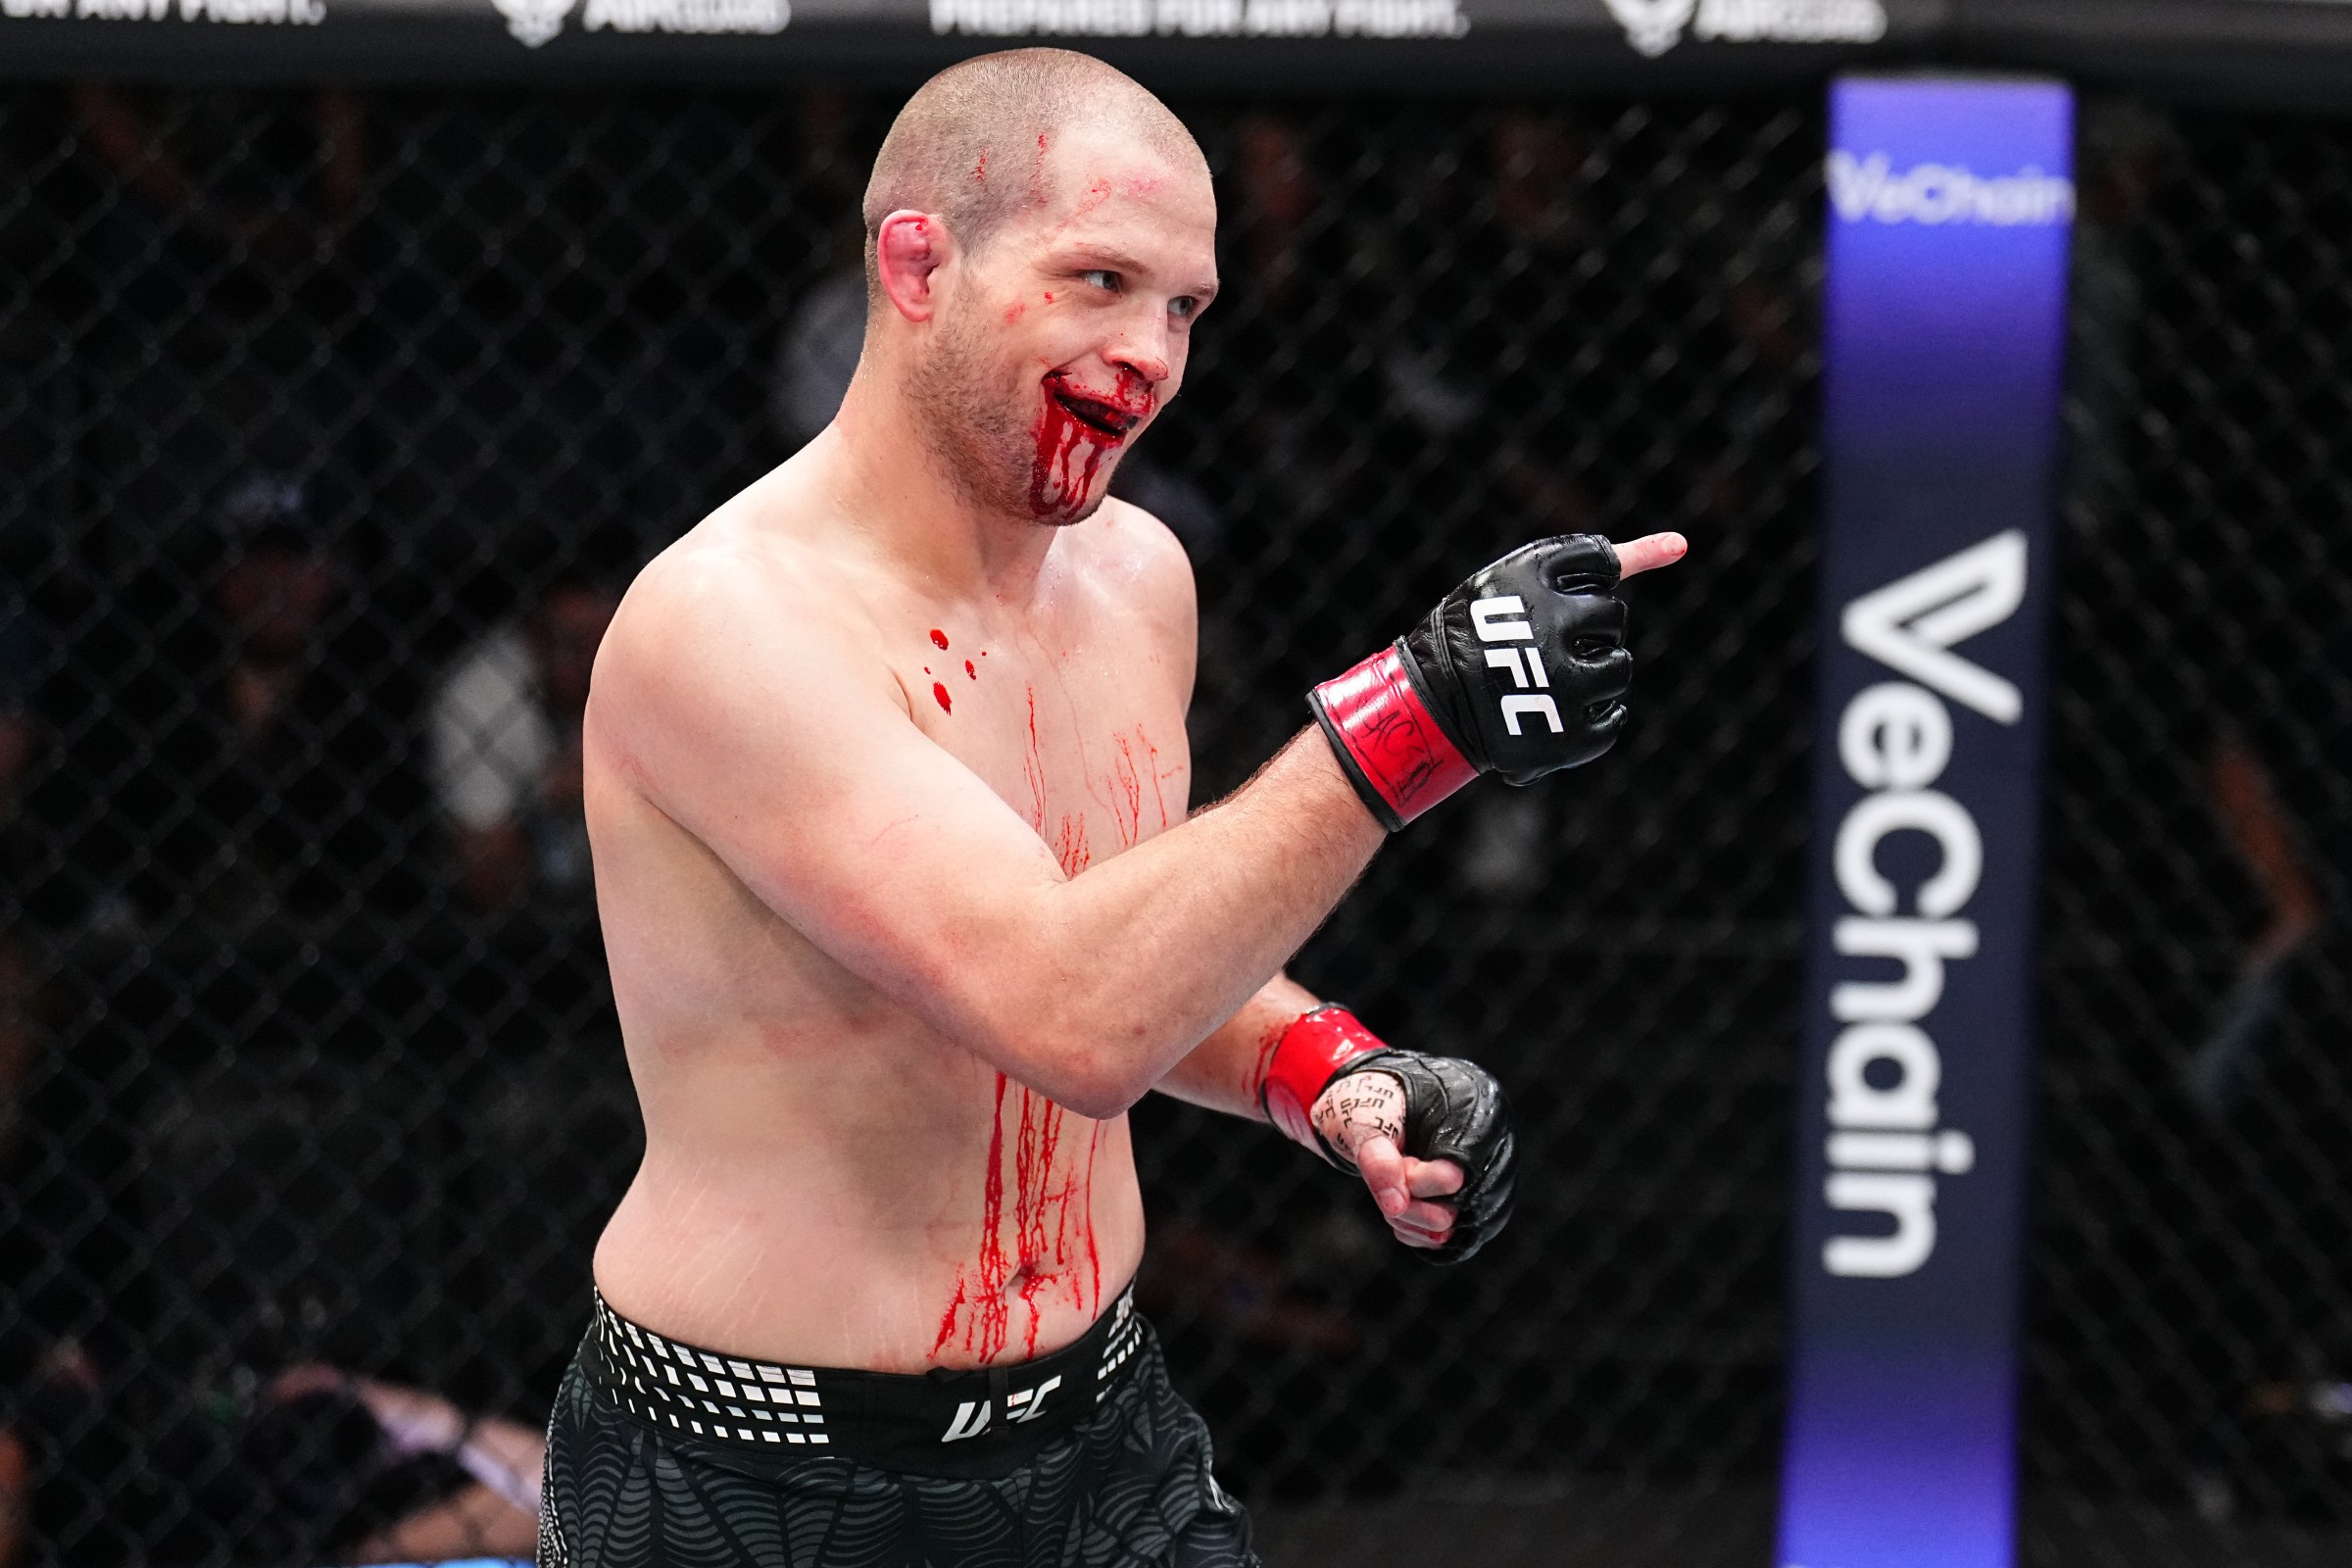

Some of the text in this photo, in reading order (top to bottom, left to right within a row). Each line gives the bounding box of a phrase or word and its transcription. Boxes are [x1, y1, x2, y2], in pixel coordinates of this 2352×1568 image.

[1824, 150, 2077, 225] VeChain
[1470, 595, 1564, 736] UFC
[1821, 527, 2030, 1279] VeChain
